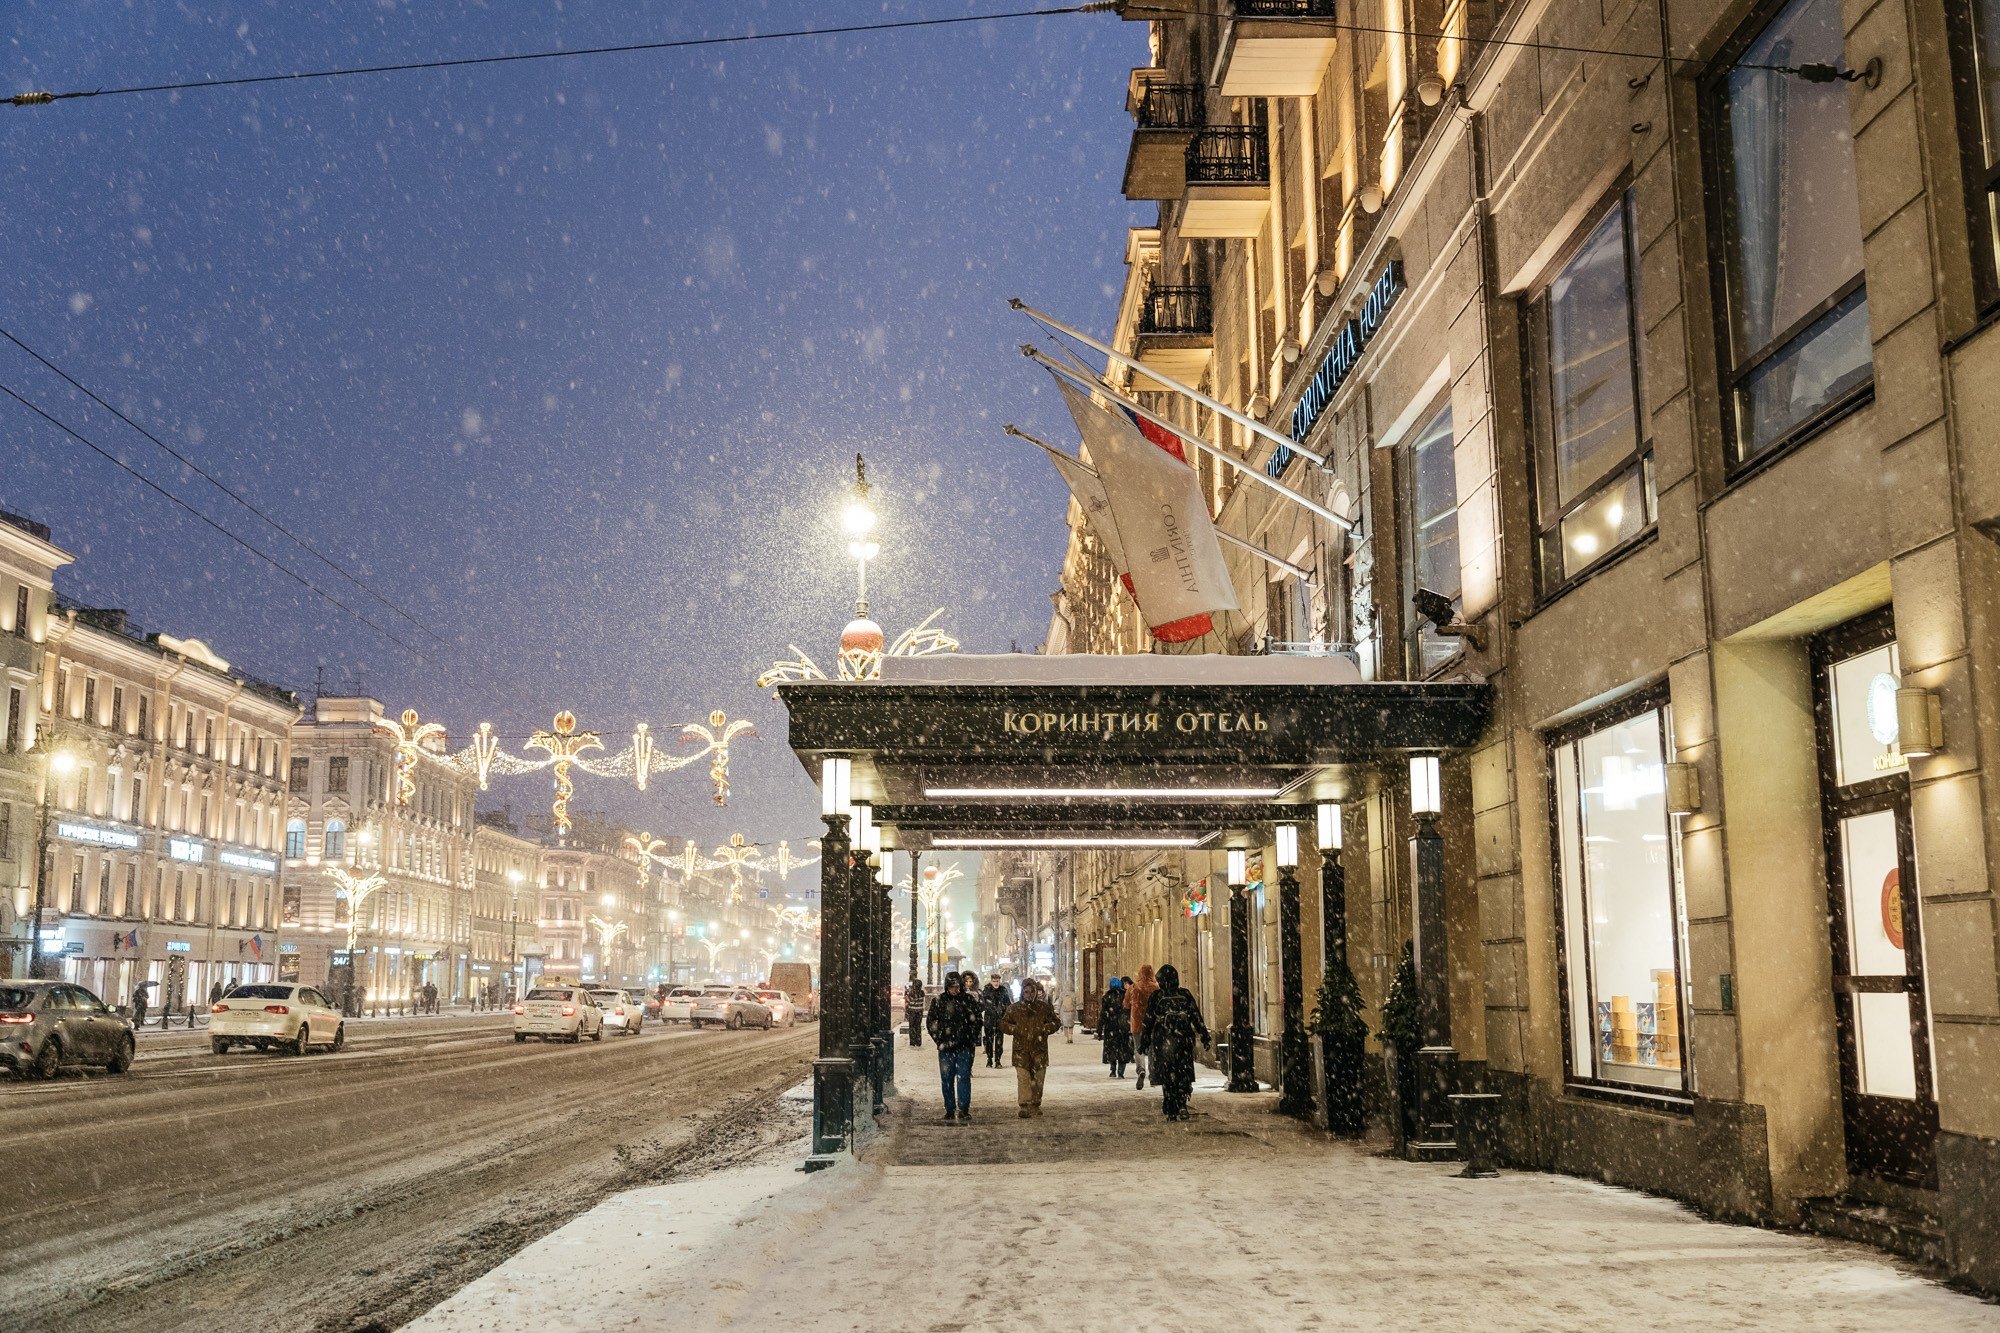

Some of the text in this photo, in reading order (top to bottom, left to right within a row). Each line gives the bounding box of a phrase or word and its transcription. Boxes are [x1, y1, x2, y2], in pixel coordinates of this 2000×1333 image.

[1291, 260, 1398, 442] CORINTHIA HOTEL
[1003, 712, 1268, 733] КОРИНТИЯ ОТЕЛЬ
